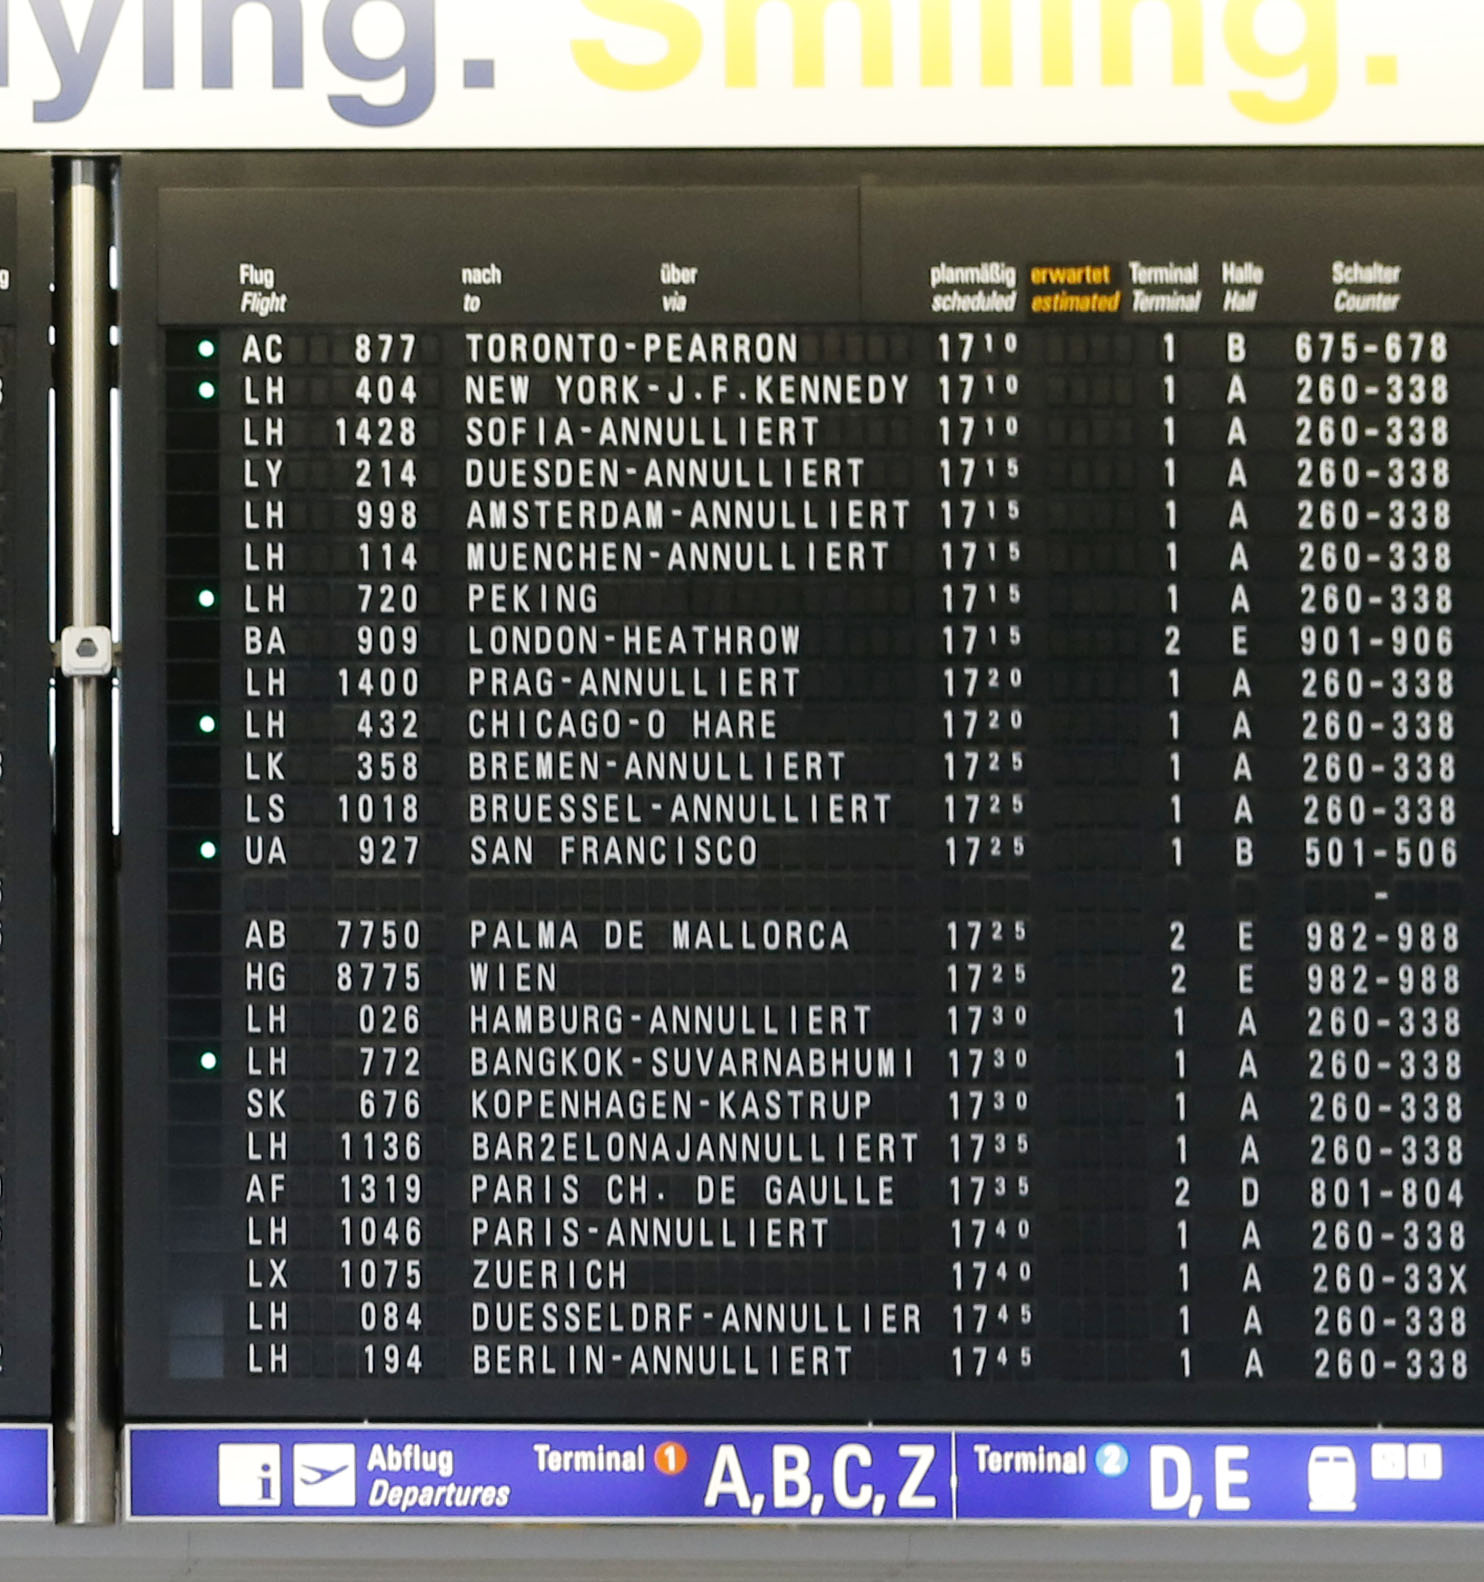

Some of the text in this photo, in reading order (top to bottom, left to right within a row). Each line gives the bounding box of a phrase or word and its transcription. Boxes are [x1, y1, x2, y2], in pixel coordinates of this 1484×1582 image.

[572, 0, 1397, 124] Smiling.
[242, 331, 1448, 364] AC 877 TORONTO-PEARRON 675-678
[465, 374, 530, 405] NEW
[466, 416, 819, 447] SOFIA-ANNULLIERT
[468, 583, 597, 613] PEKING
[245, 624, 1453, 657] BA 909 LONDON-HEATHROW 901-906
[468, 708, 776, 739] CHICAGO-O HARE
[470, 834, 757, 866] SAN FRANCISCO
[245, 919, 1459, 953] AB 7750 PALMA DE MALLORCA 982-988
[471, 1046, 912, 1078] BANGKOK-SUVARNABHUMI
[472, 1216, 829, 1248] PARIS-ANNULLIERT
[473, 1258, 625, 1290] ZUERICH
[473, 1344, 852, 1376] BERLIN-ANNULLIERT
[368, 1444, 453, 1477] Abflug
[534, 1445, 644, 1471] Terminal
[663, 1446, 677, 1470] 1
[975, 1445, 1085, 1473] Terminal
[1103, 1447, 1122, 1472] 2
[370, 1480, 510, 1509] Departures
